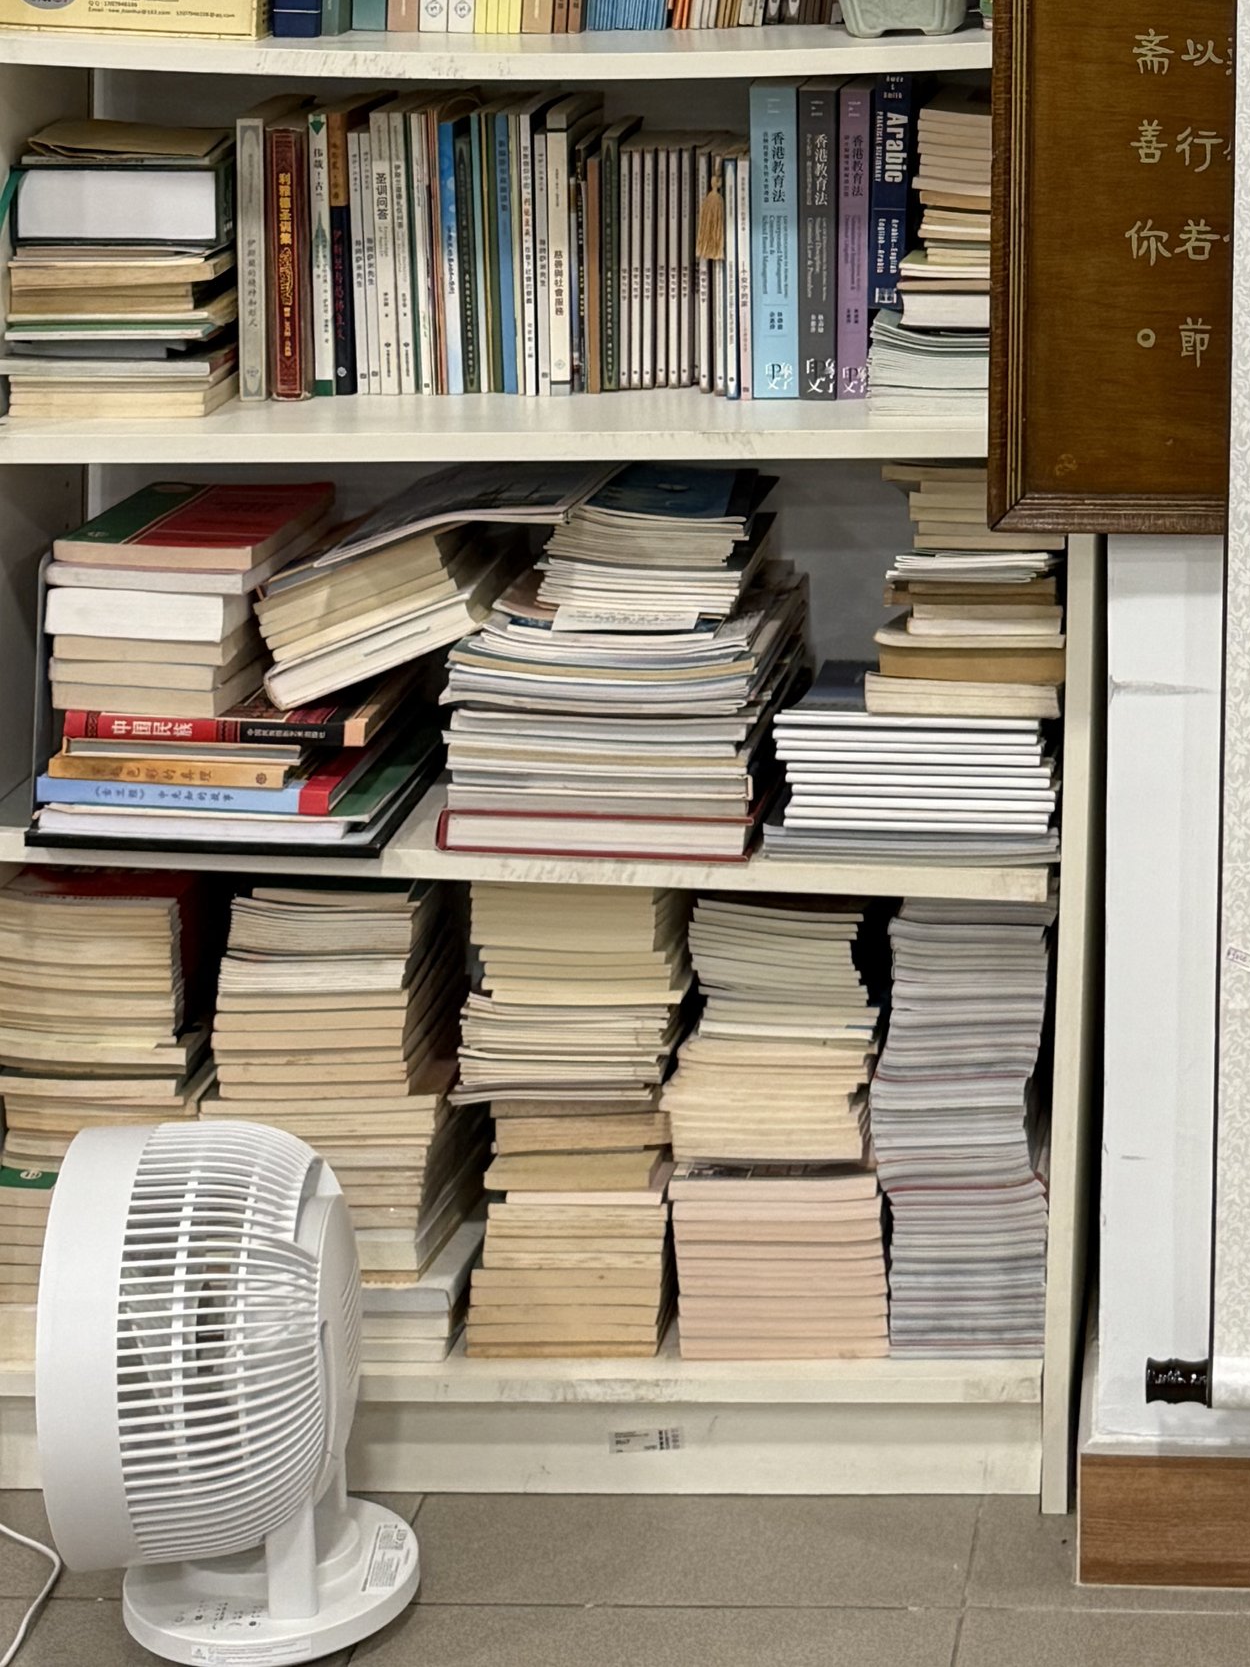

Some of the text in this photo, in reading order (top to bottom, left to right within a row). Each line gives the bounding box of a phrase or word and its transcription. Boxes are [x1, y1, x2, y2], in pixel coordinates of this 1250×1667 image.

[875, 111, 883, 144] PRACTICAL
[884, 112, 909, 183] Arabic
[375, 172, 389, 220] 圣训问答
[771, 131, 787, 203] 香港教育法
[814, 133, 828, 206] 香港教育法
[851, 135, 864, 197] 香港教育法
[554, 250, 564, 316] 慈善與社會服務
[111, 720, 193, 737] 中国民族
